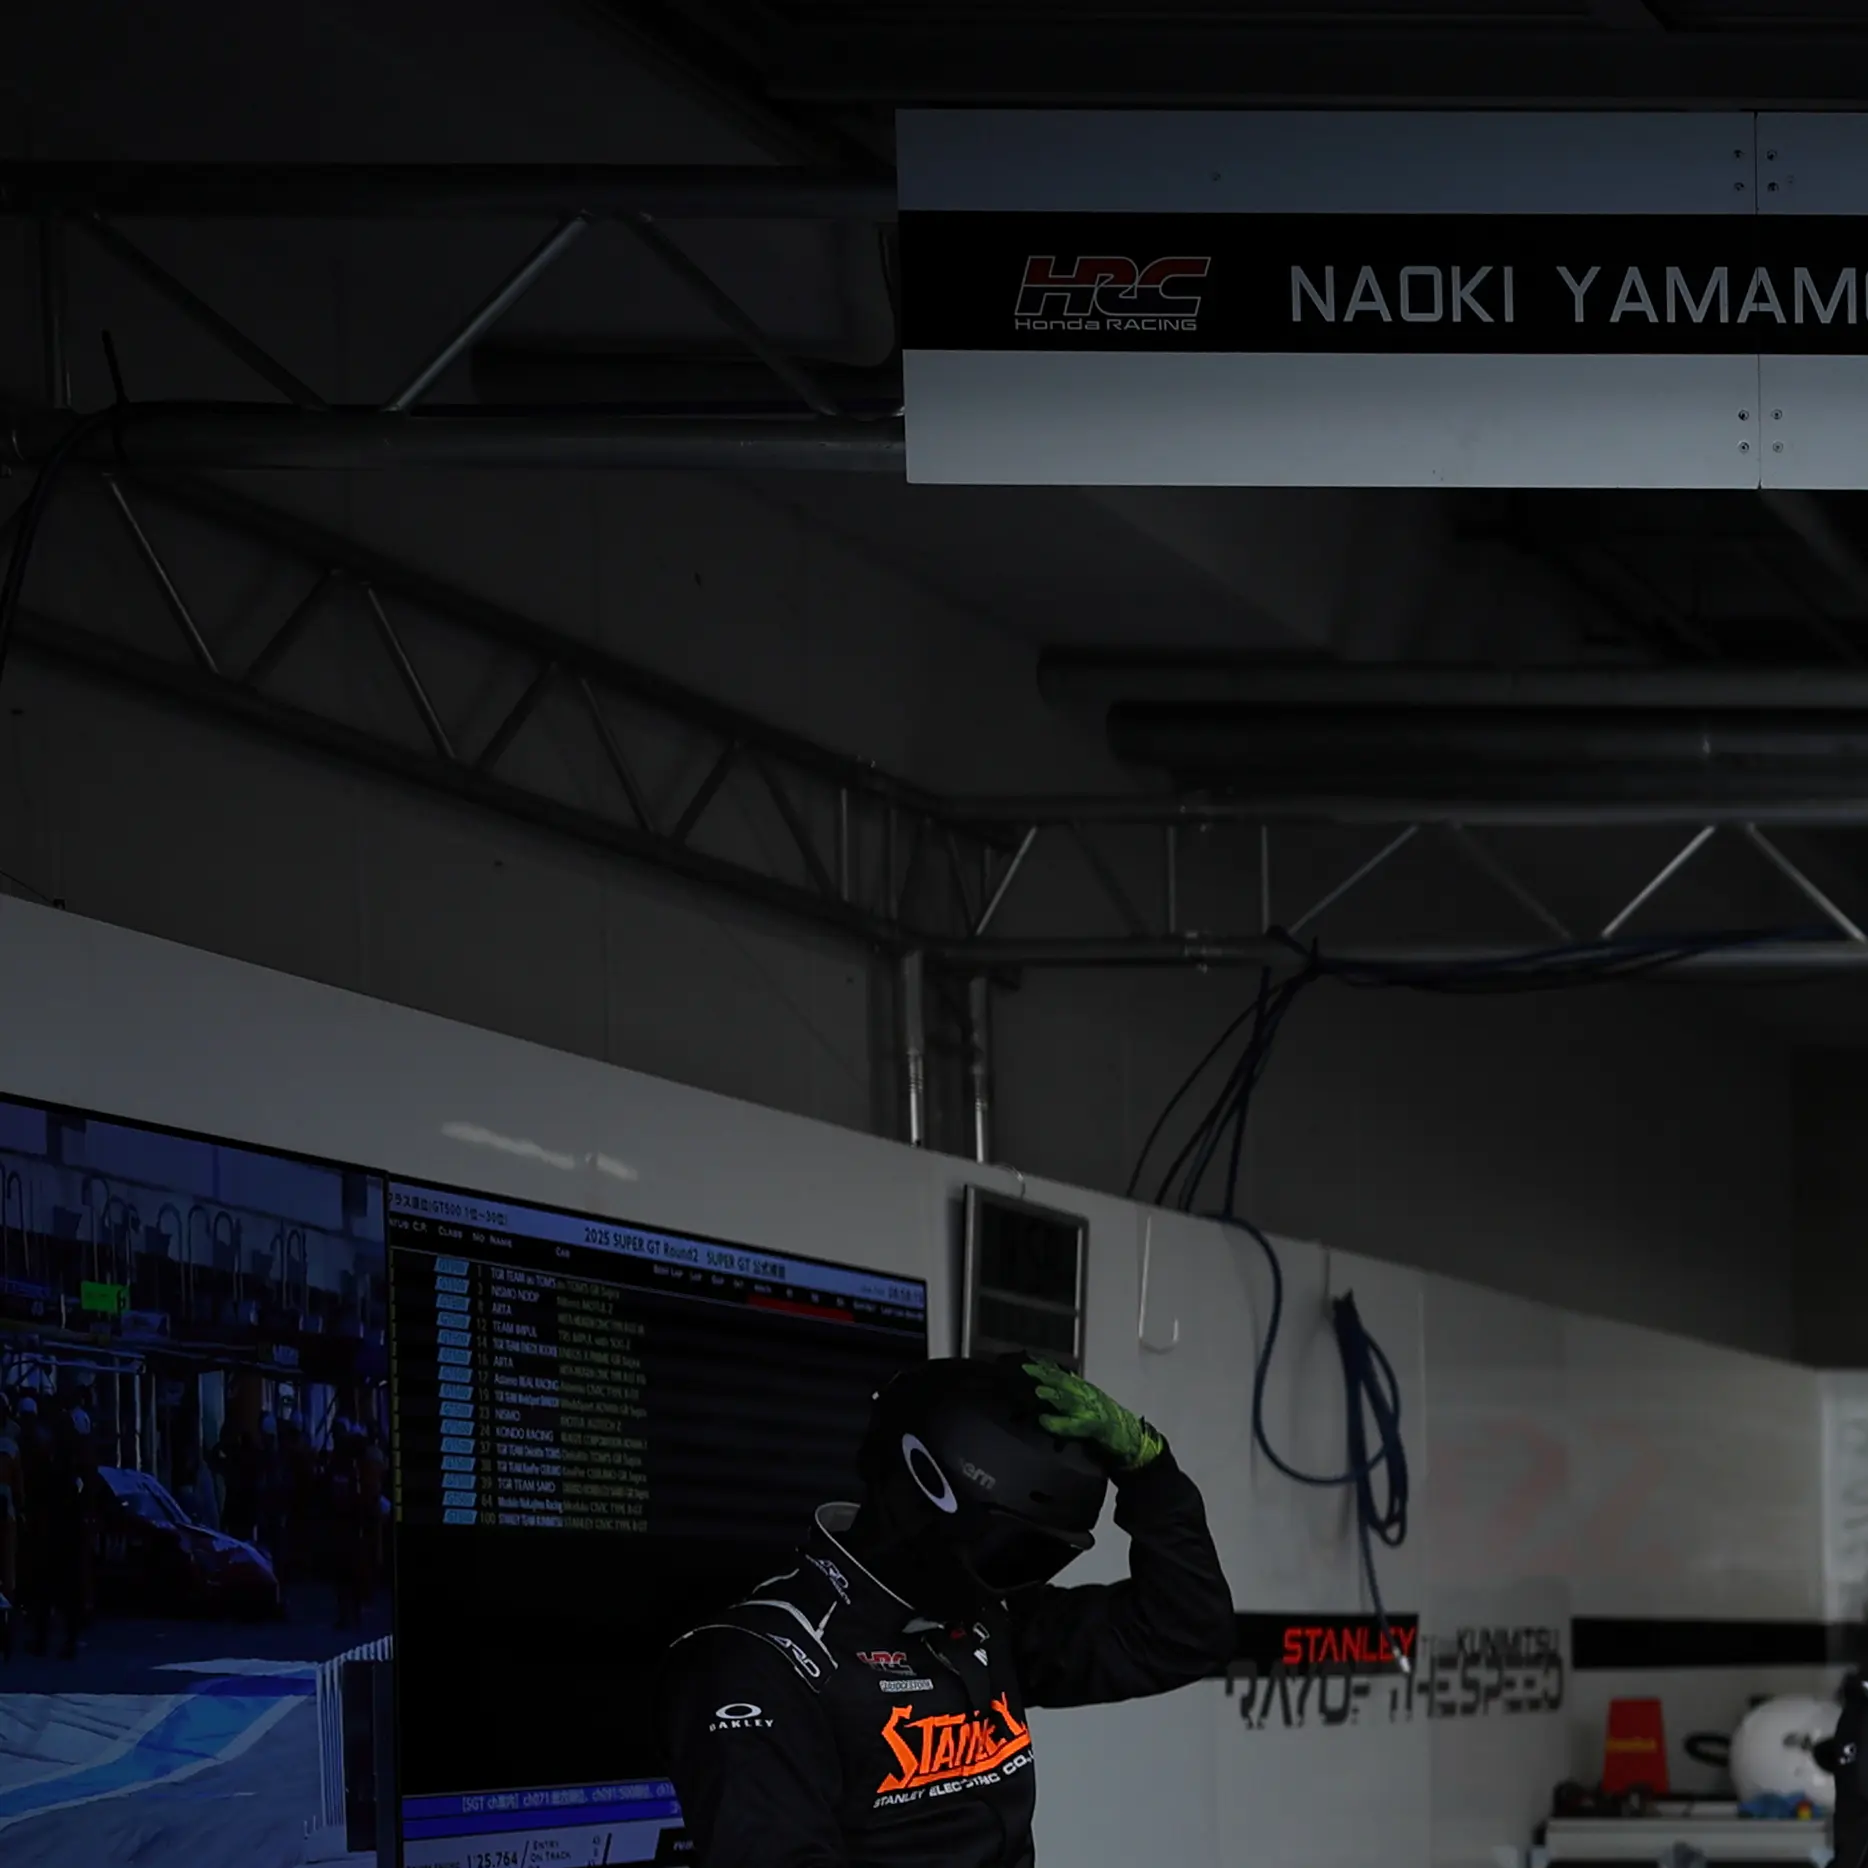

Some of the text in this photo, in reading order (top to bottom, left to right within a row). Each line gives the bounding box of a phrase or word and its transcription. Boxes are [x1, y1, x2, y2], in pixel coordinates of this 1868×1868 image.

[1013, 254, 1212, 318] HRC
[1290, 264, 1515, 324] NAOKI
[1014, 318, 1198, 332] Honda RACING
[585, 1227, 610, 1249] 2025
[612, 1232, 645, 1255] SUPER
[647, 1238, 662, 1258] GT
[706, 1248, 736, 1271] SUPER
[1281, 1625, 1416, 1665] STANLEY
[709, 1718, 775, 1733] OAKLEY
